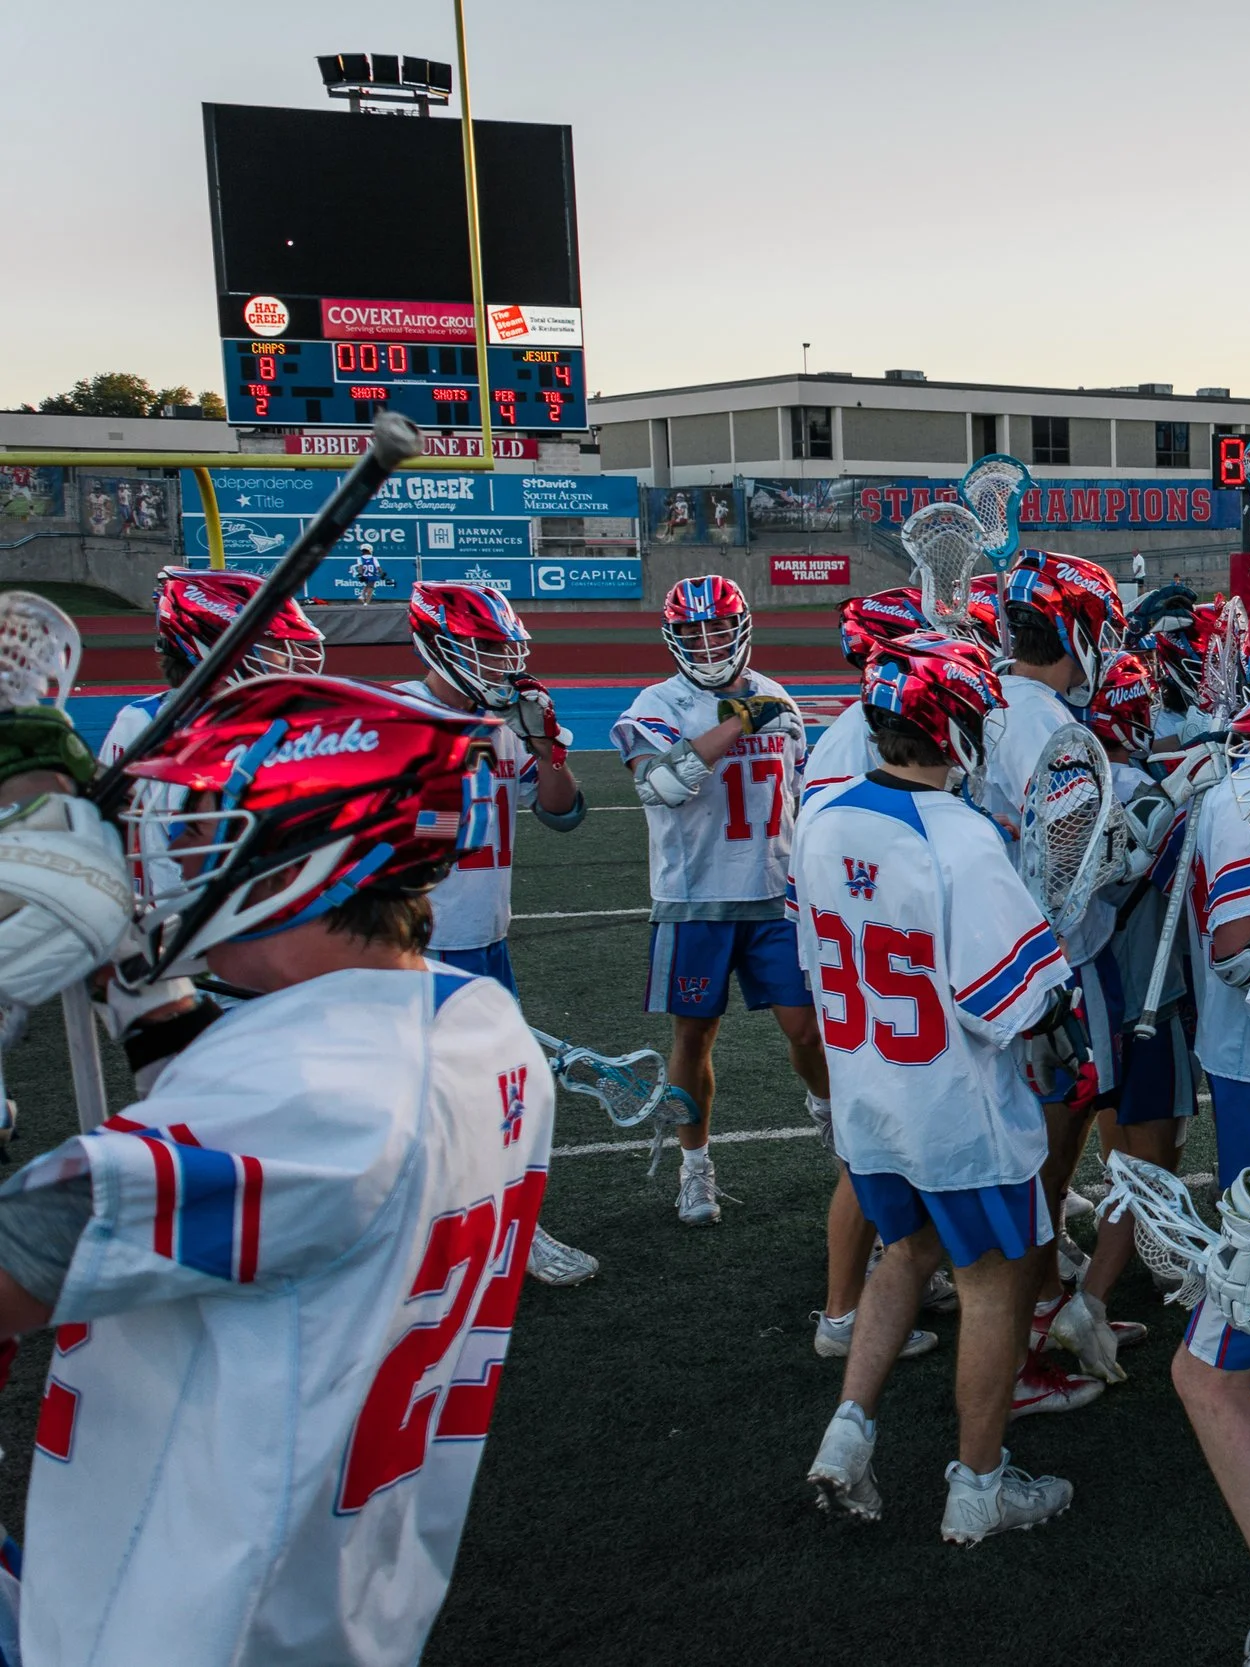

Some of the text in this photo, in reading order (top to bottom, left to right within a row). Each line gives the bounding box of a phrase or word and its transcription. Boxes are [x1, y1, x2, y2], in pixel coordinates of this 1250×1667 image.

[254, 303, 278, 313] HAT
[248, 313, 285, 324] CREEK
[328, 306, 477, 328] COVERT AUTO GROU
[492, 311, 510, 321] The
[497, 317, 524, 329] Steam
[345, 325, 374, 335] Serving
[375, 326, 402, 334] Central
[500, 328, 524, 339] Team
[251, 343, 286, 354] CHAPS
[522, 351, 560, 362] JESUIT
[259, 357, 275, 380] 8
[555, 365, 571, 386] 4
[248, 384, 271, 397] TOL
[351, 388, 386, 399] SHOTS
[433, 389, 468, 400] SHOTS
[494, 390, 516, 402] PER
[543, 392, 564, 403] TOL
[256, 398, 269, 416] 2
[549, 405, 561, 421] 2
[500, 405, 516, 425] 4
[301, 436, 360, 454] EBBIE
[210, 476, 314, 490] ndependence
[253, 494, 285, 508] Title
[379, 500, 457, 512] Burger Company
[860, 488, 1212, 524] STAT HAMPIONS
[774, 561, 845, 570] MARK HURST
[569, 570, 637, 580] CAPITAL
[792, 571, 829, 580] TRACK
[721, 758, 784, 842] 17
[810, 905, 949, 1065] 35
